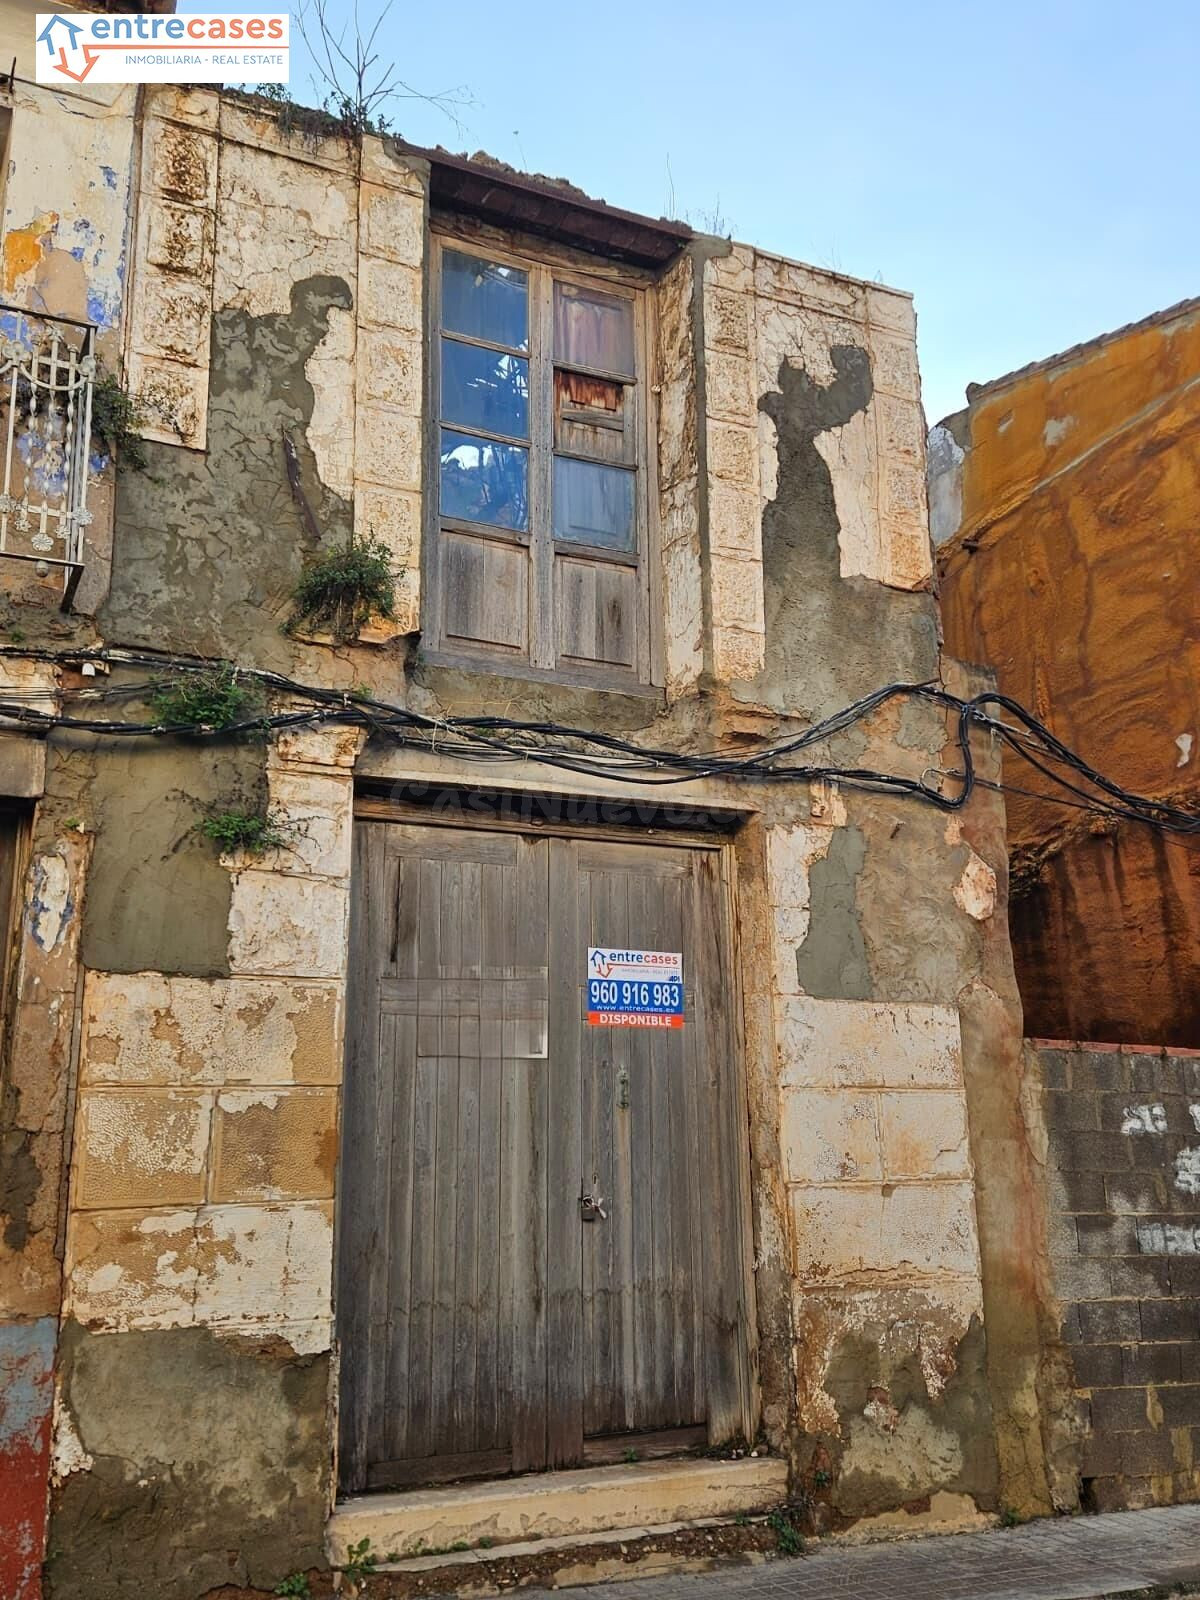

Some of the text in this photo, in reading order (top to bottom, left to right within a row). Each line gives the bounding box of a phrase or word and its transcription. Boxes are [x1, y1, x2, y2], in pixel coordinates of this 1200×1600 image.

[609, 951, 678, 965] entrecases
[591, 981, 679, 1007] 960 916 983
[599, 1013, 672, 1026] DISPONIBLE
